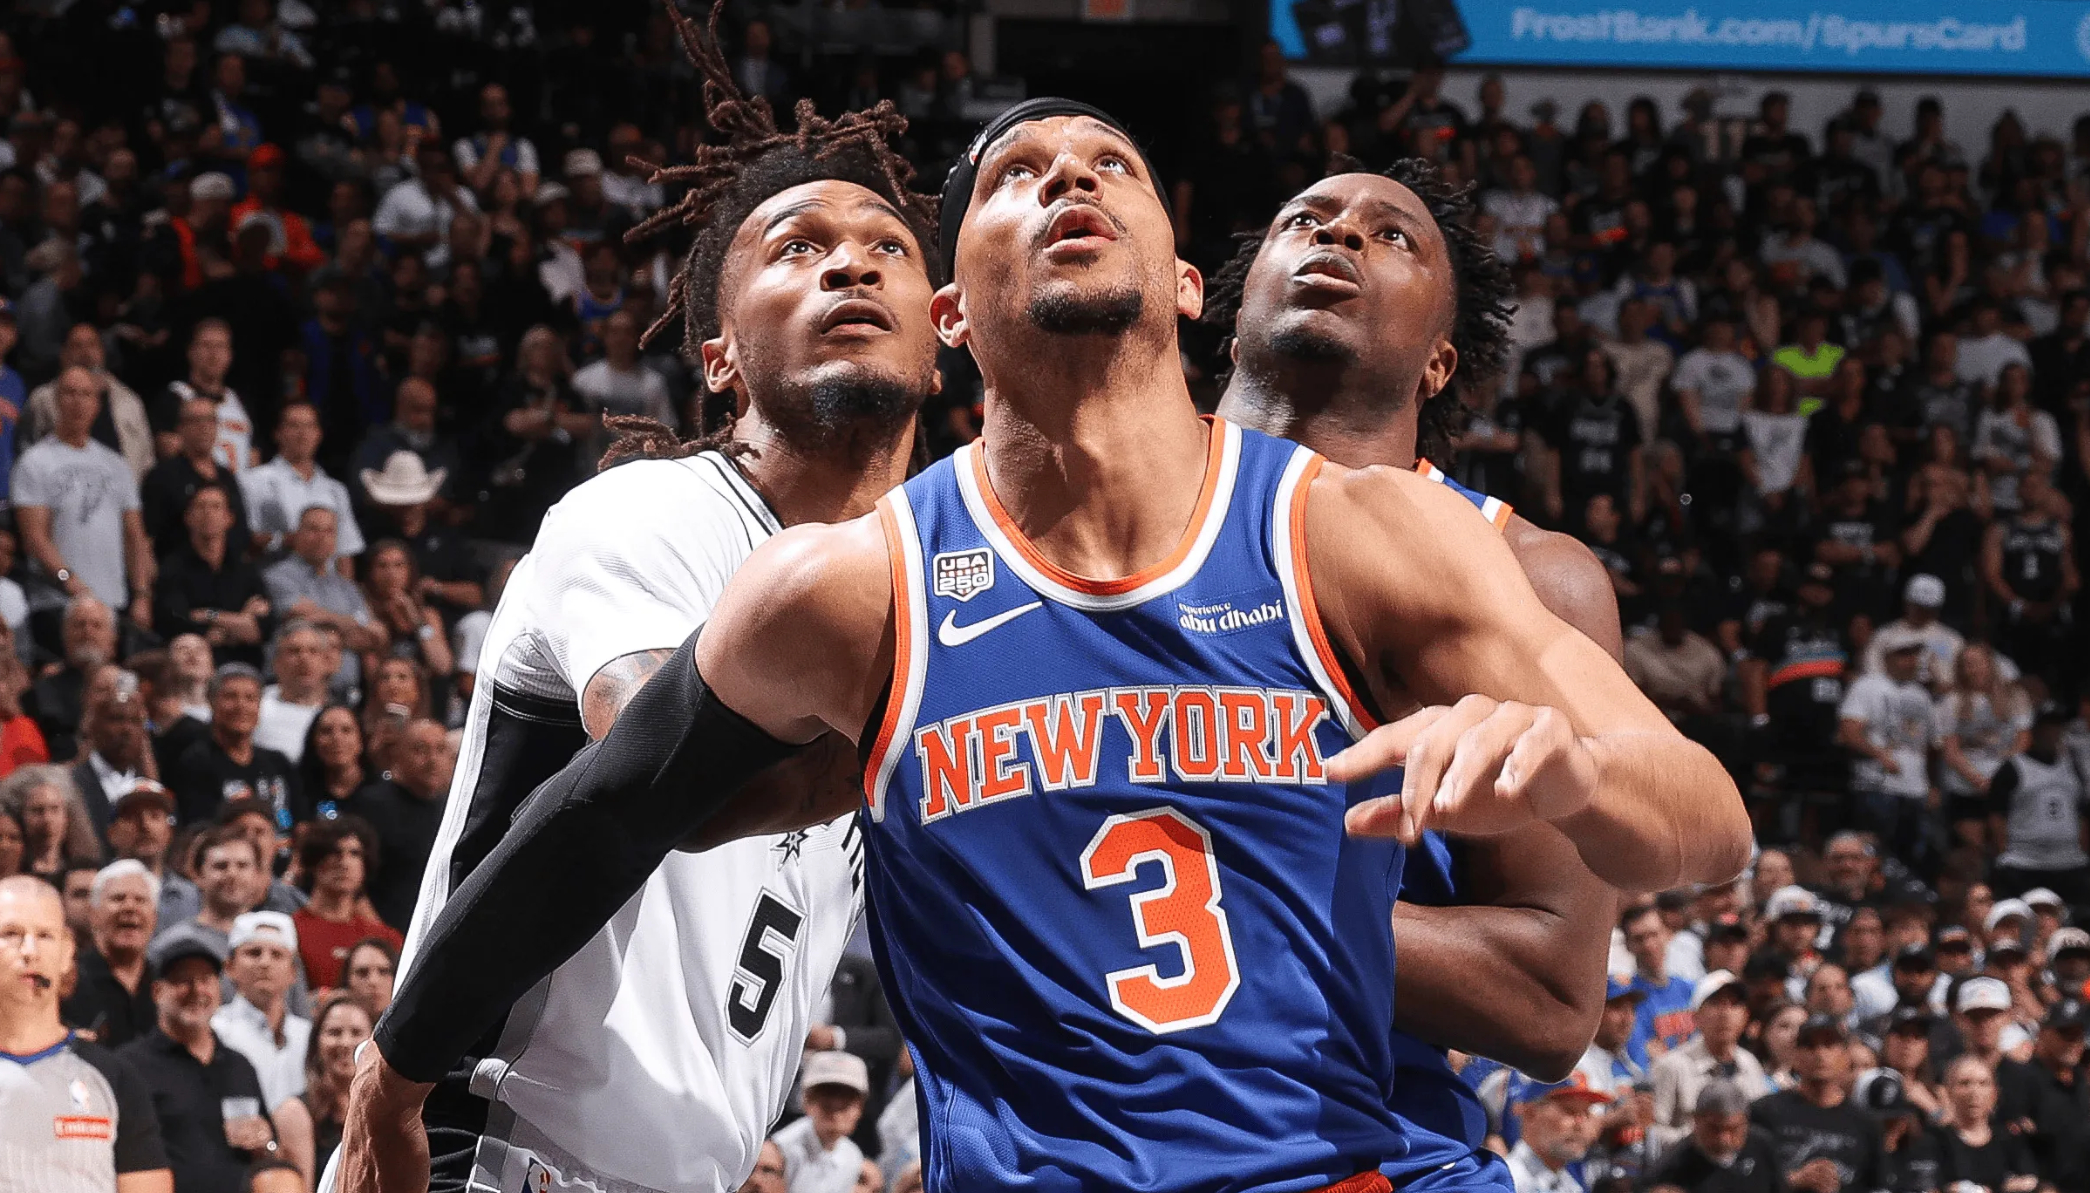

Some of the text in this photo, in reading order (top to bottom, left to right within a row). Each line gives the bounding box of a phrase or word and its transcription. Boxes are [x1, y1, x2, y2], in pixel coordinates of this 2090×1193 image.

[1512, 8, 2026, 55] FrostBank.com/SpursCard
[939, 572, 989, 591] 250
[941, 554, 986, 570] USA
[1180, 599, 1283, 633] abu dhabi
[914, 685, 1330, 826] NEW YORK
[1079, 806, 1241, 1035] 3
[724, 886, 808, 1048] 5
